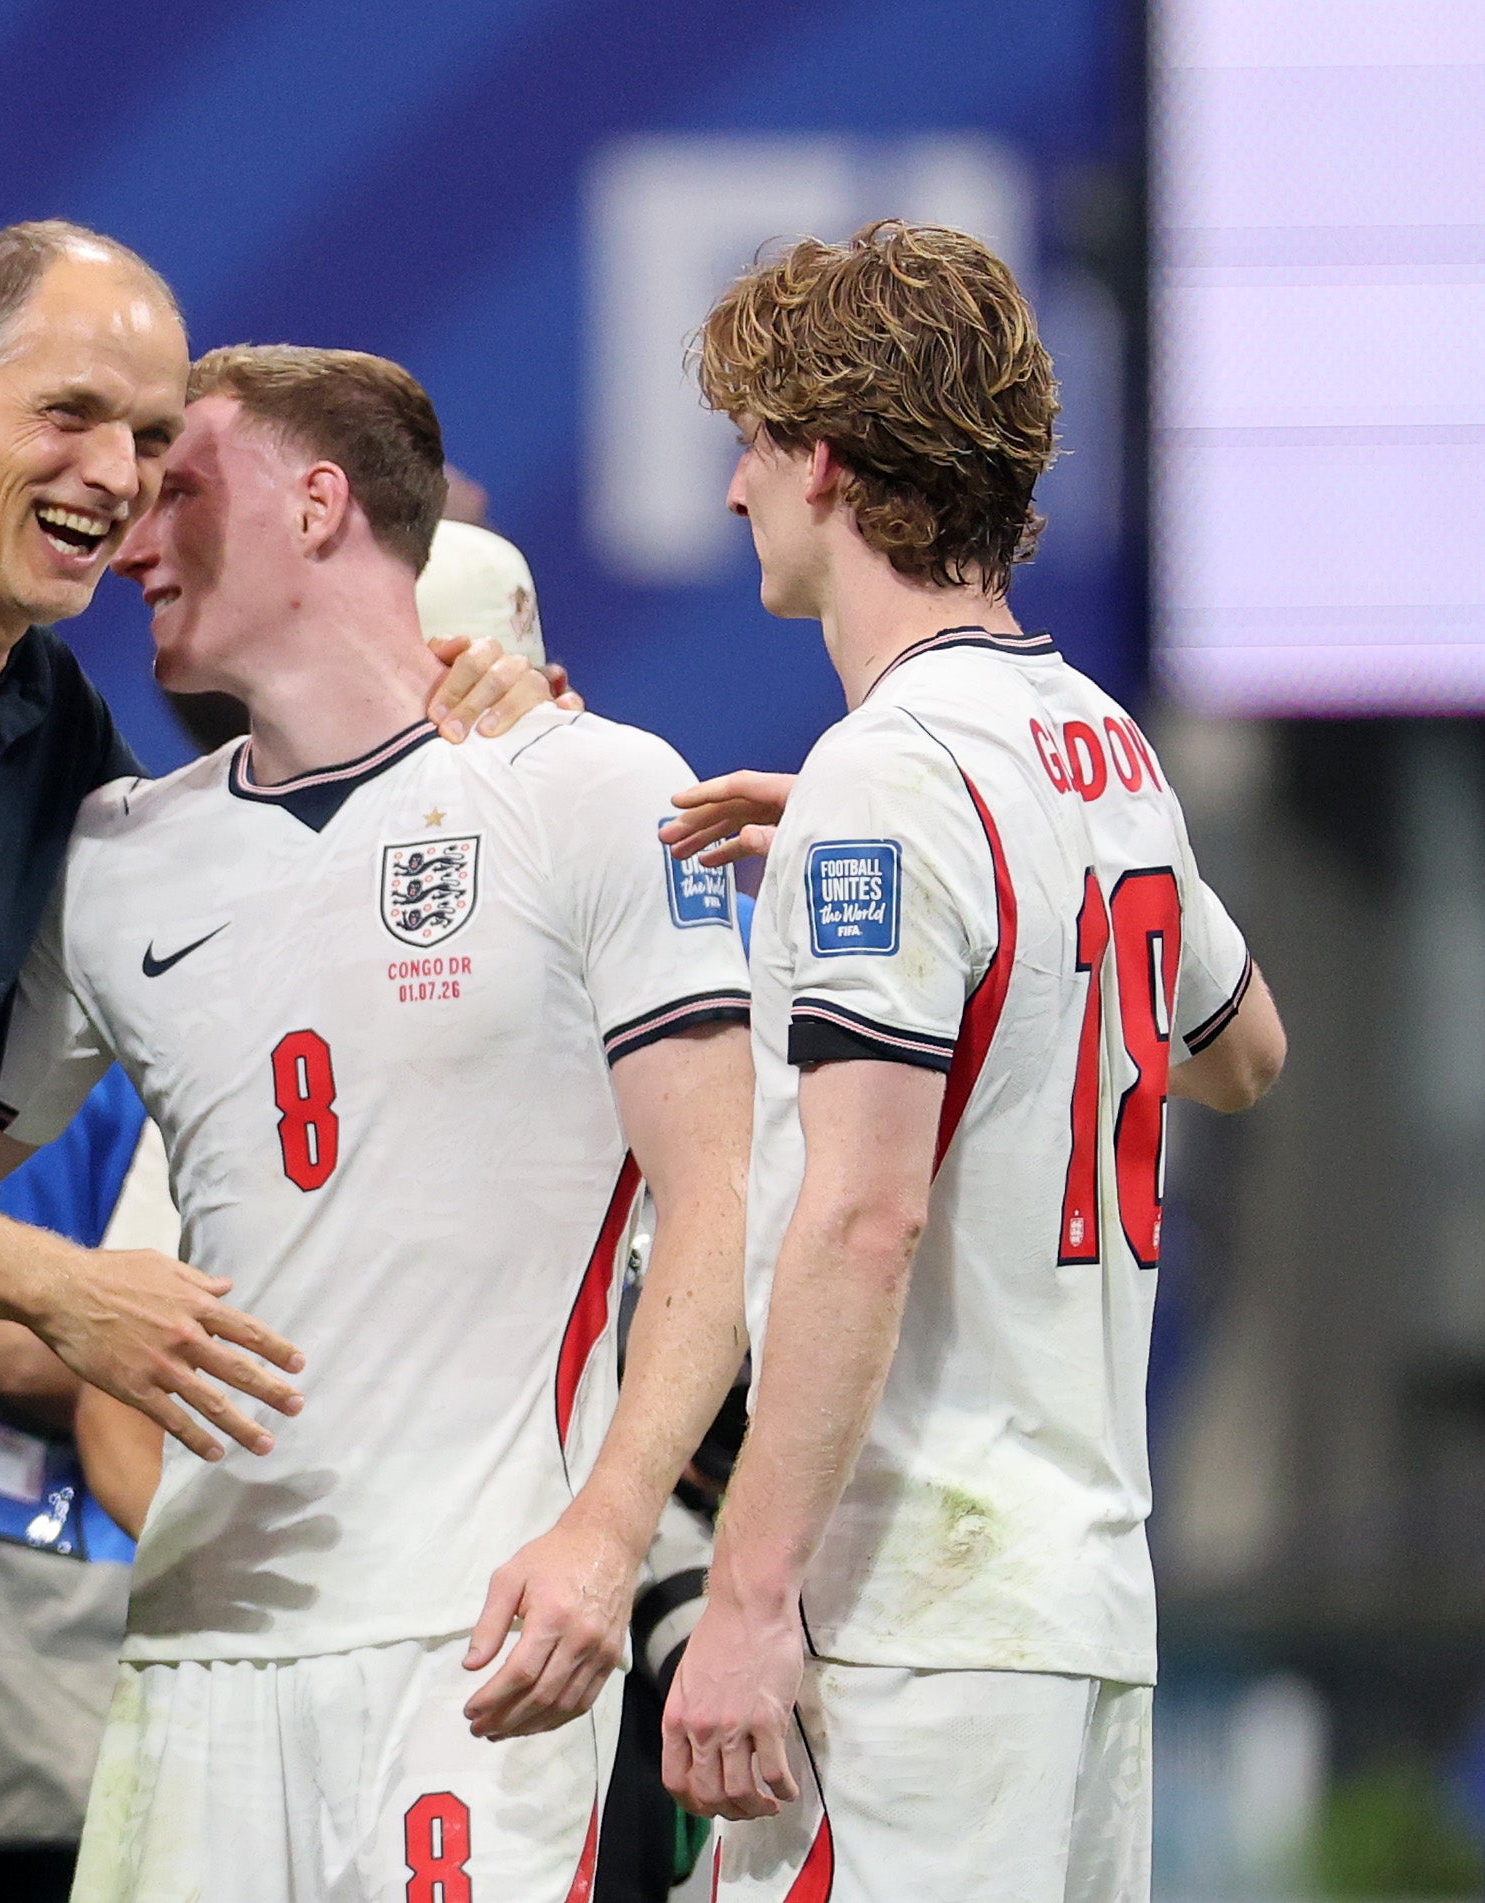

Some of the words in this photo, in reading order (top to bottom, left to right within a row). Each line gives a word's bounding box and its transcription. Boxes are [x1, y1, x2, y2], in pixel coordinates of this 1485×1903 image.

[820, 858, 883, 878] FOOTBALL
[821, 876, 883, 902] UNITES
[819, 903, 842, 925] the
[842, 901, 886, 924] World
[388, 957, 443, 980] CONGO
[449, 956, 472, 976] DR
[399, 981, 460, 1002] 01.07.26
[1057, 865, 1182, 1270] 18
[271, 1028, 339, 1192] 8
[403, 1790, 473, 1903] 8
